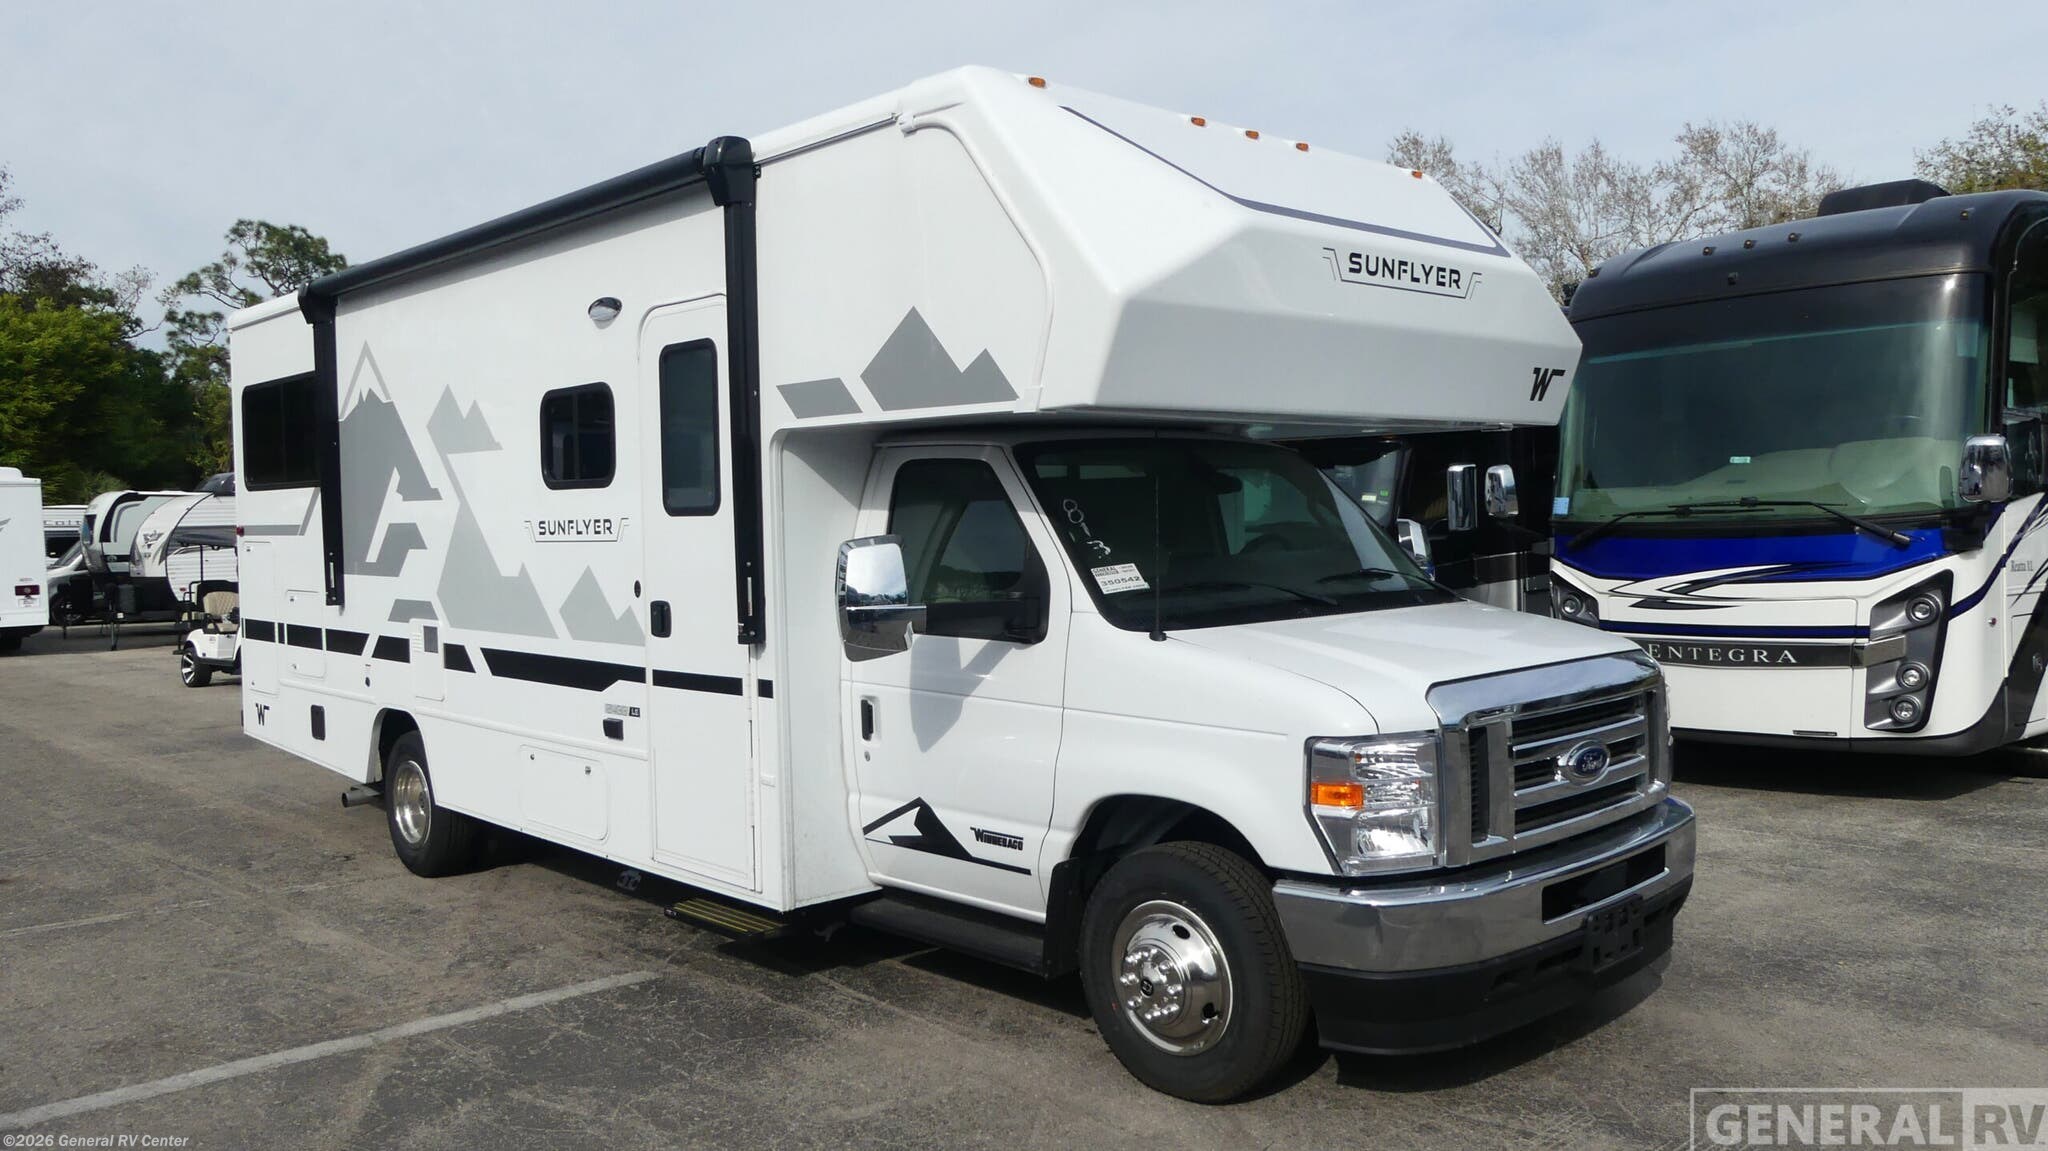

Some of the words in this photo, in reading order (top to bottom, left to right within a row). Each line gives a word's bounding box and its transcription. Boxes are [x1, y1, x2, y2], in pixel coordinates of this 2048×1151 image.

[1348, 252, 1461, 289] SUNFLYER
[538, 518, 613, 536] SUNFLYER
[1100, 576, 1141, 587] 350542
[1648, 643, 1798, 664] ENTEGRA
[1582, 752, 1603, 771] Ford
